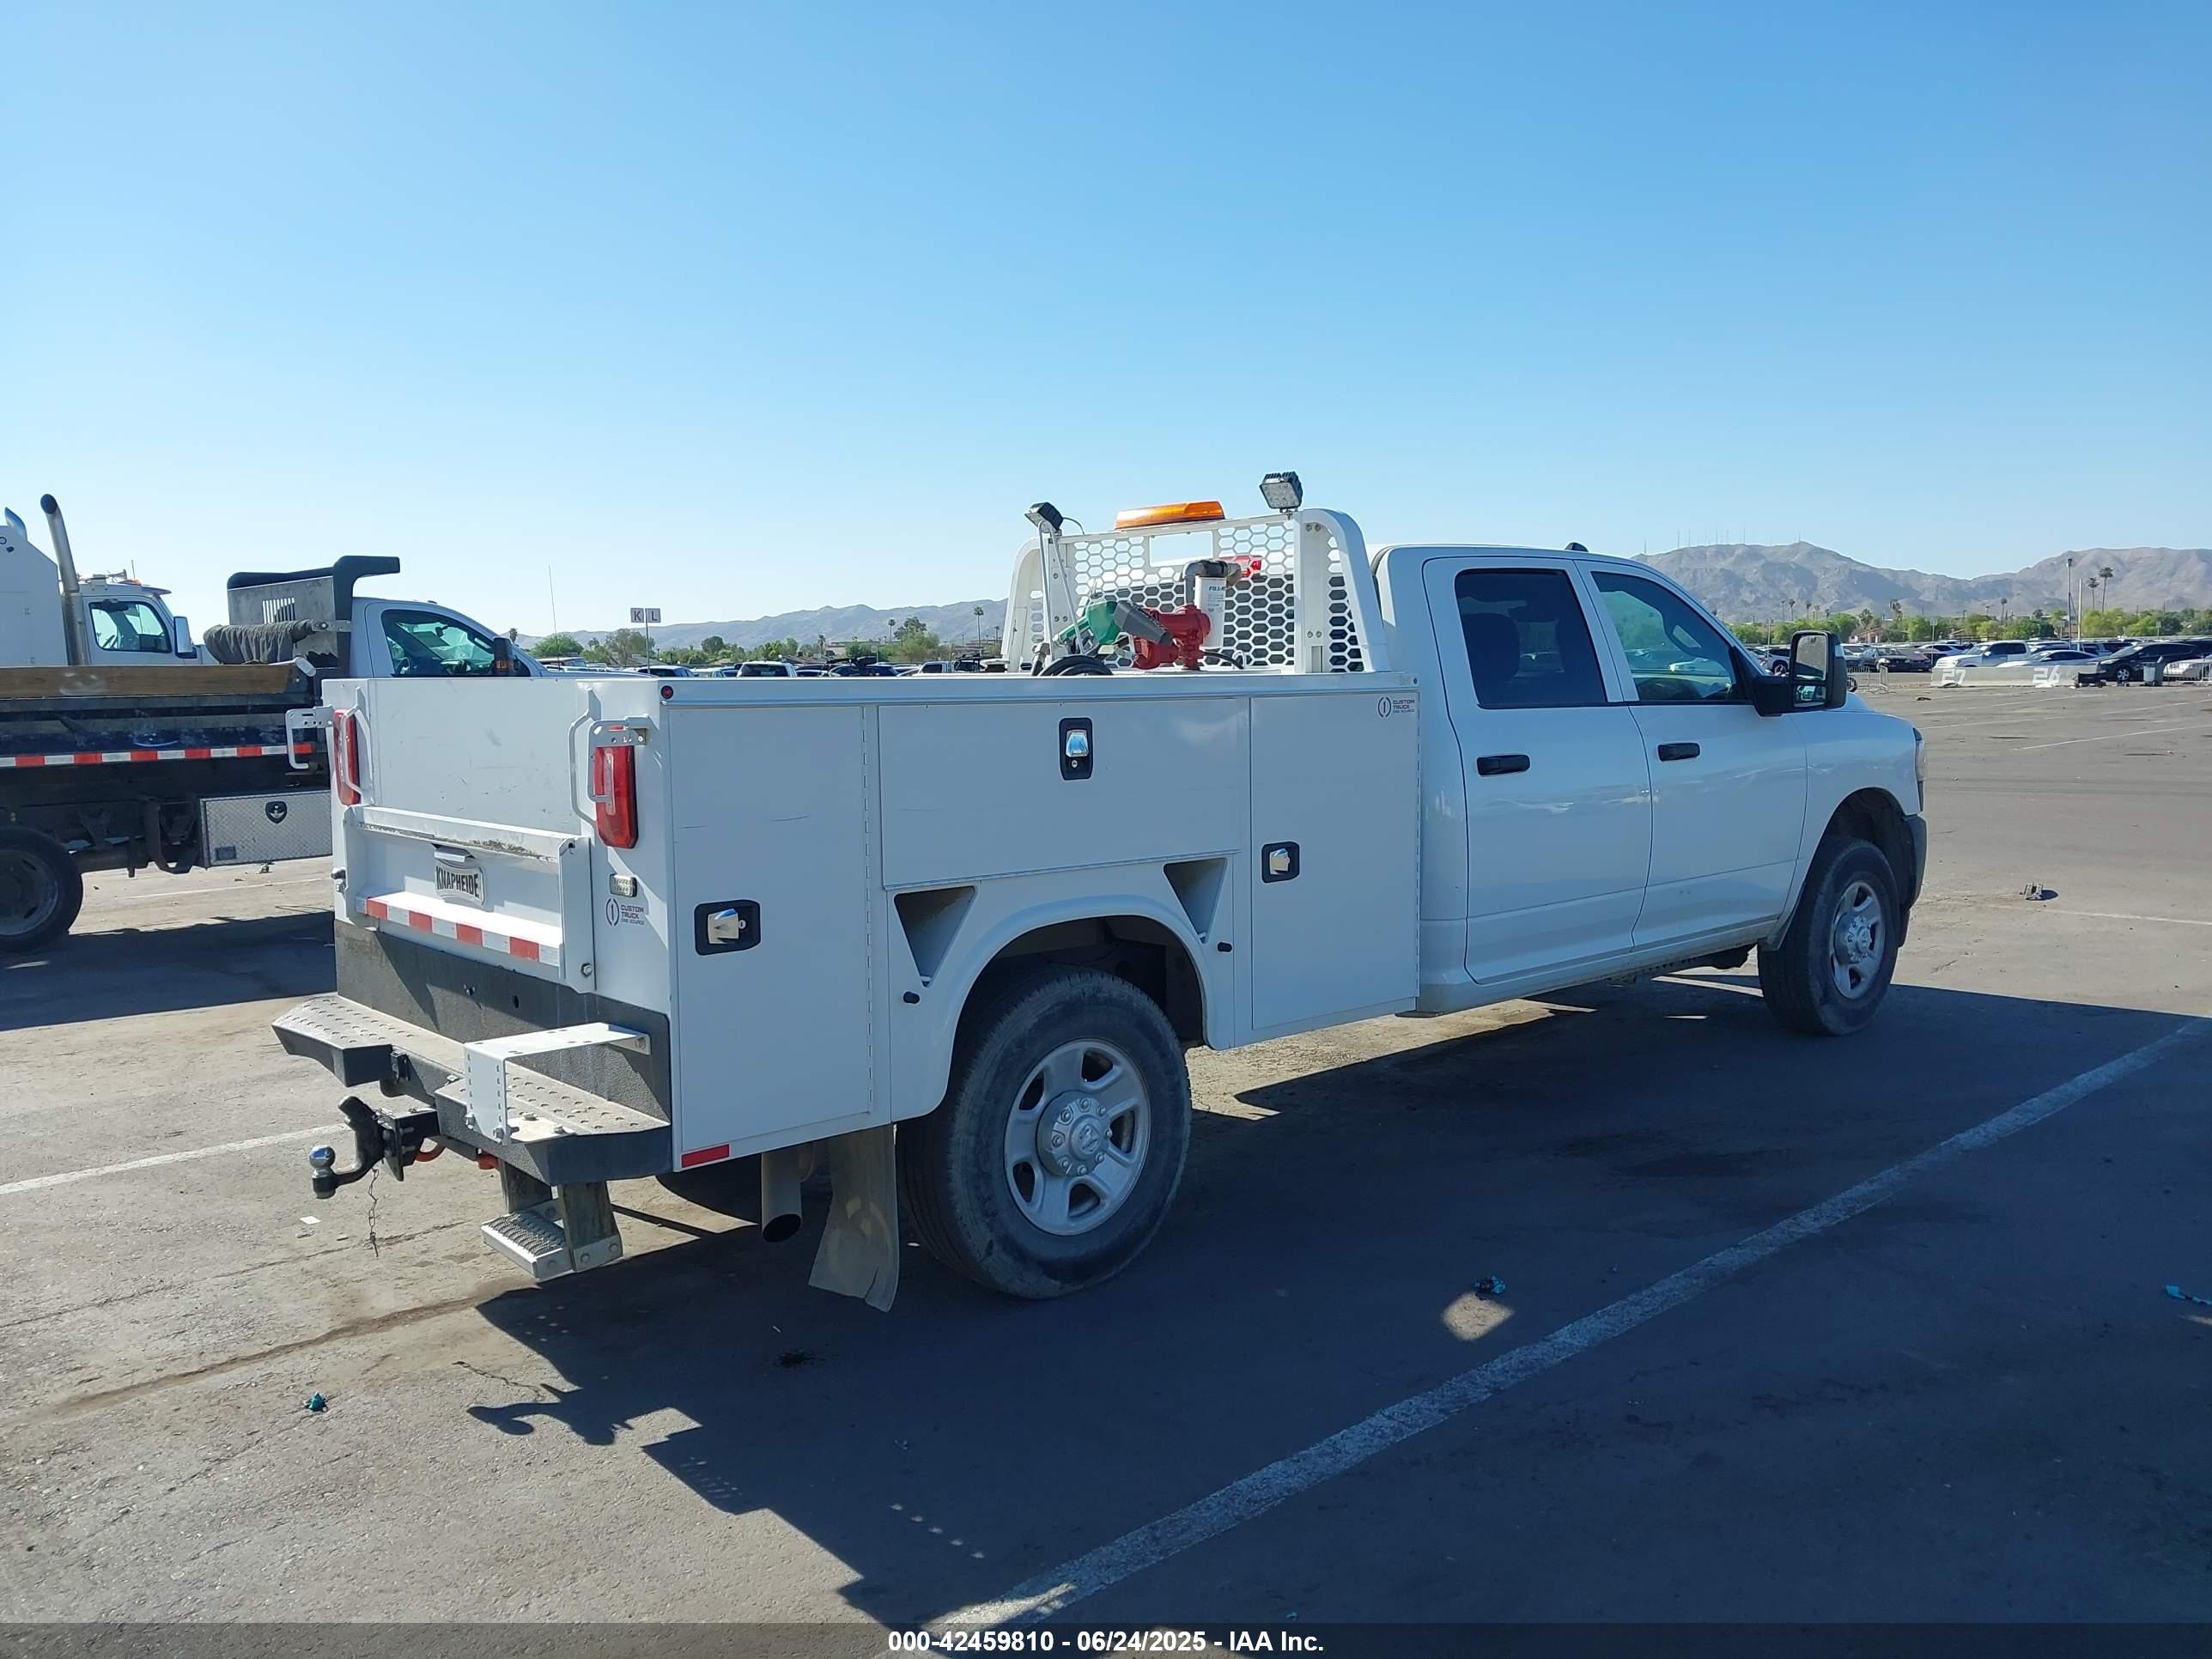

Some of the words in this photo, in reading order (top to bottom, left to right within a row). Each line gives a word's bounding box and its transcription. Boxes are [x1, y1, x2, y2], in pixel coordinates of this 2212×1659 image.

[634, 611, 641, 621] K
[651, 611, 658, 621] L
[1941, 669, 1966, 684] 27
[2032, 665, 2061, 685] 26
[435, 865, 479, 898] KNAPHEIDE
[620, 904, 644, 913] CUSTOM
[621, 911, 640, 920] TRUCK
